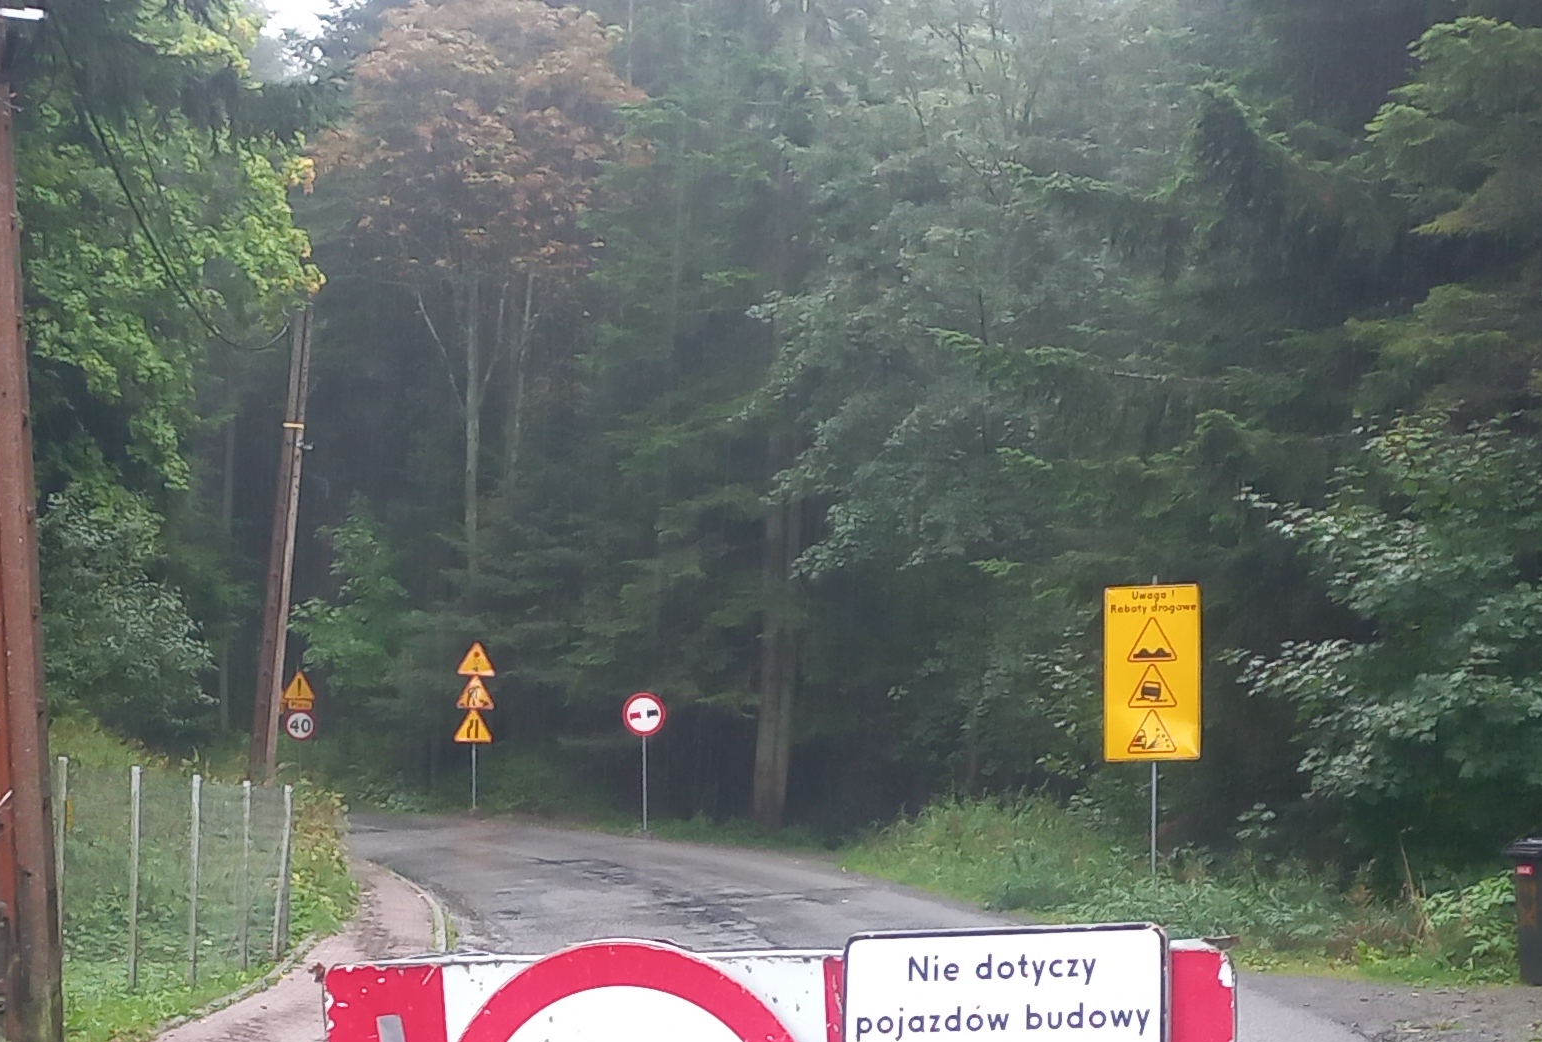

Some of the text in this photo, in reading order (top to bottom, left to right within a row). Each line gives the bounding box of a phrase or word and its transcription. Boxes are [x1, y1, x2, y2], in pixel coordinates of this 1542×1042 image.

[1131, 590, 1167, 602] Uwaga
[290, 718, 311, 733] 40
[908, 953, 1097, 987] Nie dotyczy
[855, 1002, 1151, 1042] pojazdów budowy
